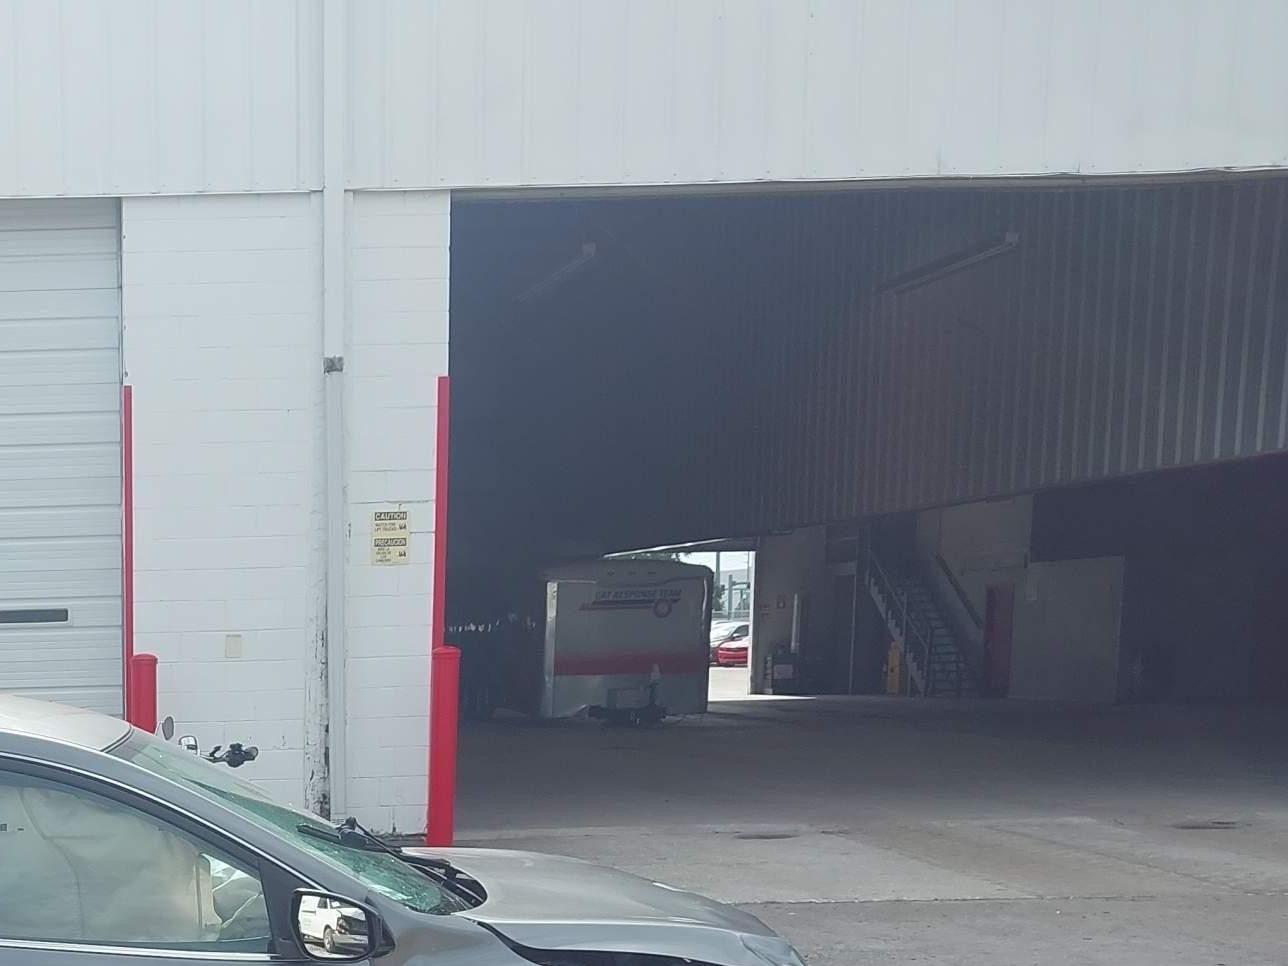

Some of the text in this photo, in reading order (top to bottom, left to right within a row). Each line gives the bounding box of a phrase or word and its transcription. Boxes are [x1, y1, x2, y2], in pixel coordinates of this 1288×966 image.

[375, 512, 407, 520] CAUTION
[613, 590, 656, 598] RESPONSE
[658, 589, 682, 597] TEAM
